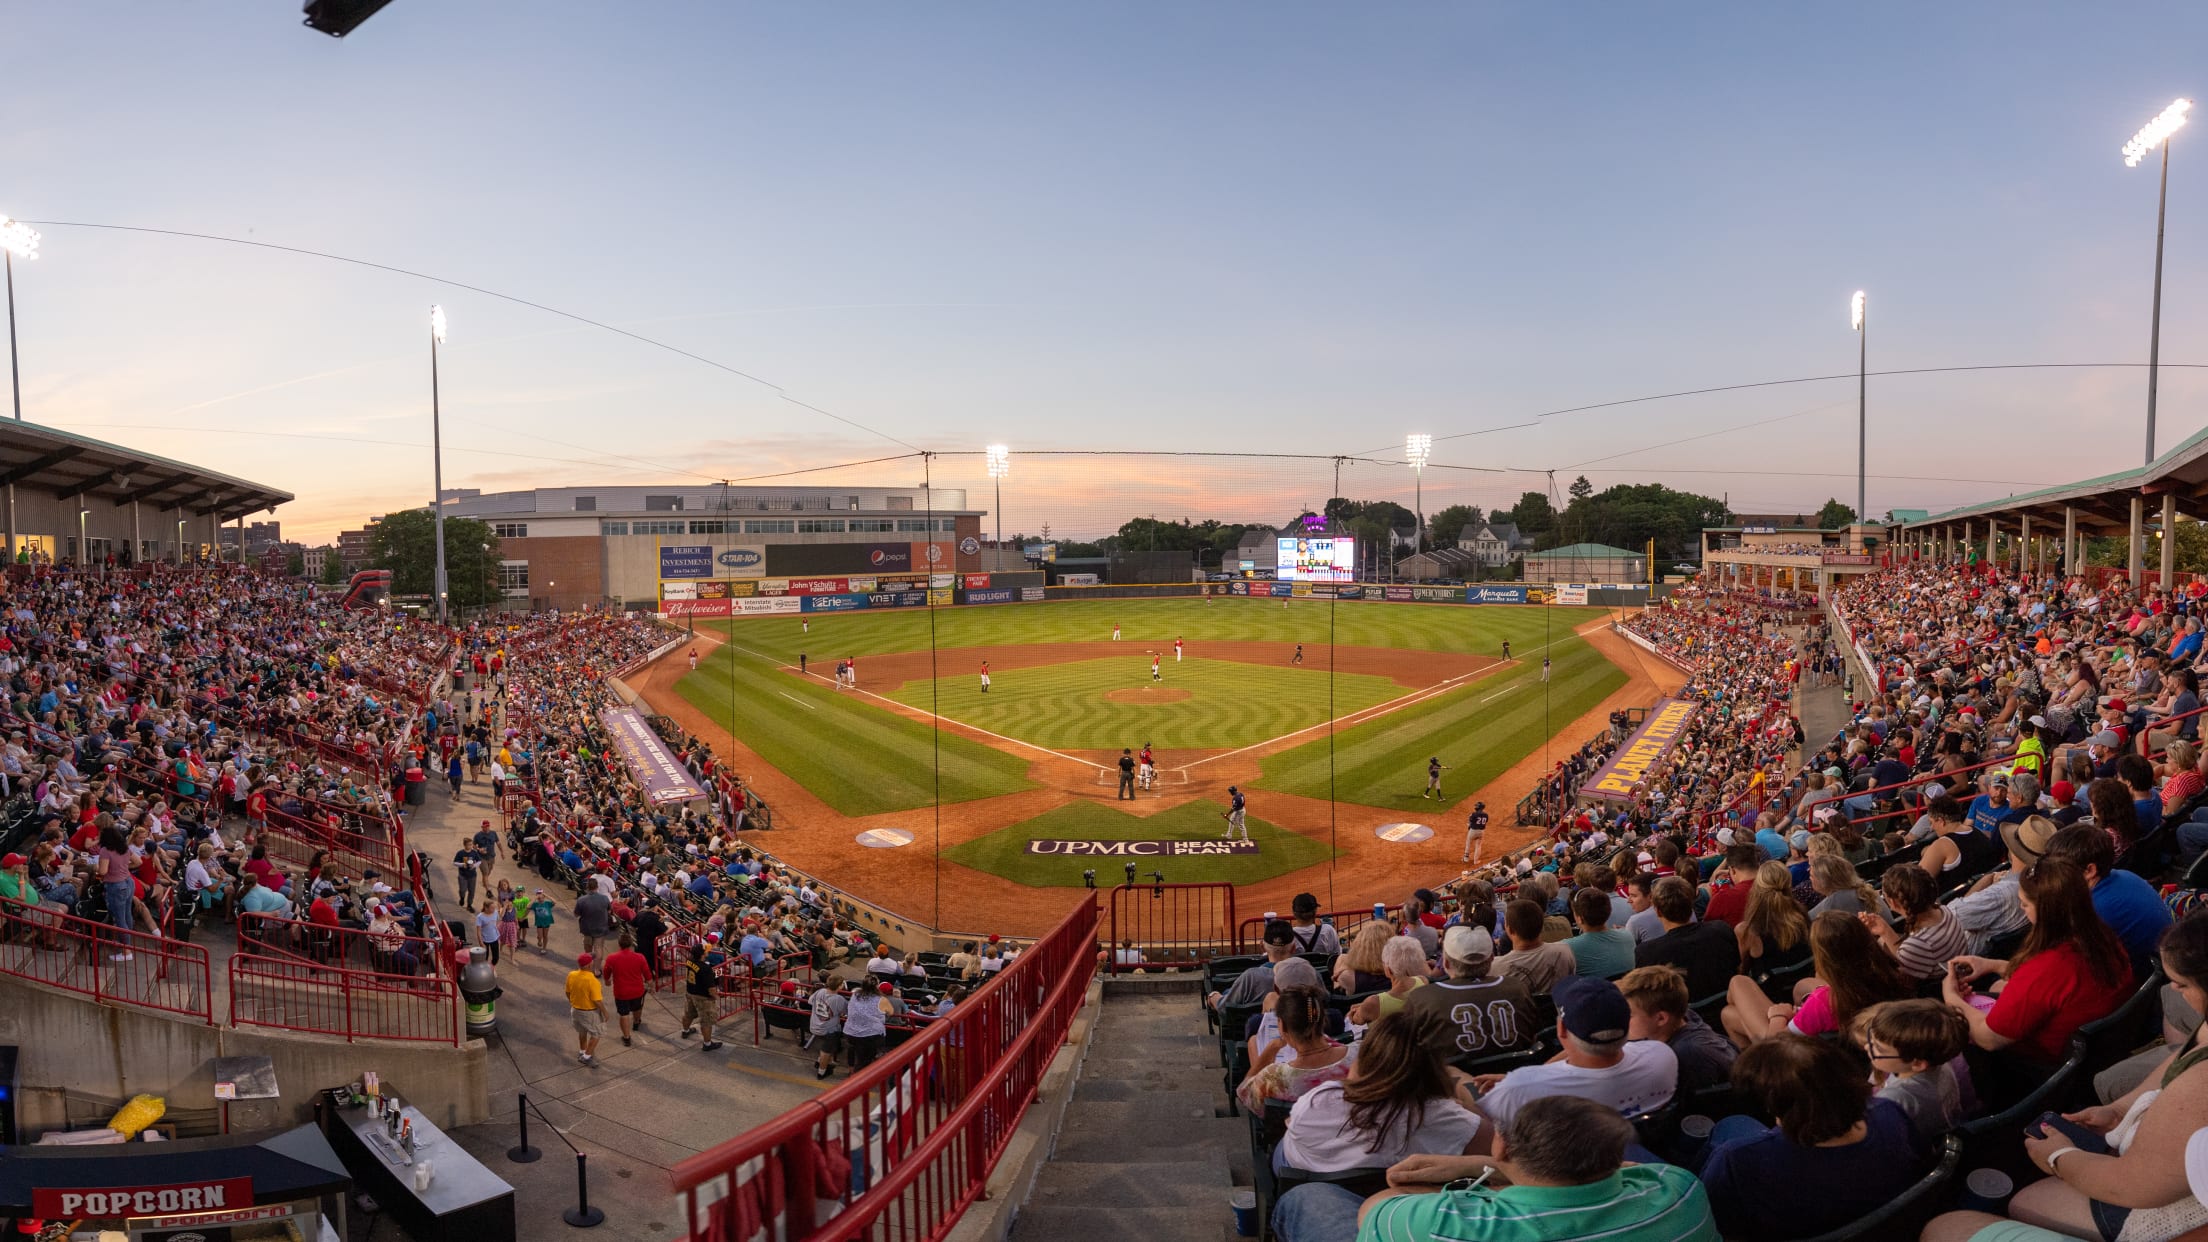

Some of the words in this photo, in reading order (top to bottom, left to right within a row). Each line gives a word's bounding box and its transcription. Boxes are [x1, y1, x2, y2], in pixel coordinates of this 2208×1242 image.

[1302, 516, 1328, 524] UPMC
[886, 553, 907, 562] pepsi
[662, 559, 711, 567] INVESTMENTS
[969, 593, 986, 601] BUD
[987, 591, 1010, 600] LIGHT
[1421, 589, 1455, 598] MERCYHURST
[1472, 589, 1519, 600] Marquette
[823, 597, 841, 607] Erie
[666, 602, 726, 615] Budweiser
[1595, 738, 1665, 793] PLANET
[1642, 702, 1692, 739] FITNESS
[652, 751, 669, 765] HERE
[661, 763, 676, 775] FOR
[1476, 817, 1487, 825] 20
[1031, 840, 1159, 855] UPMC
[1451, 1000, 1518, 1052] 30
[61, 1184, 226, 1217] POPCORN
